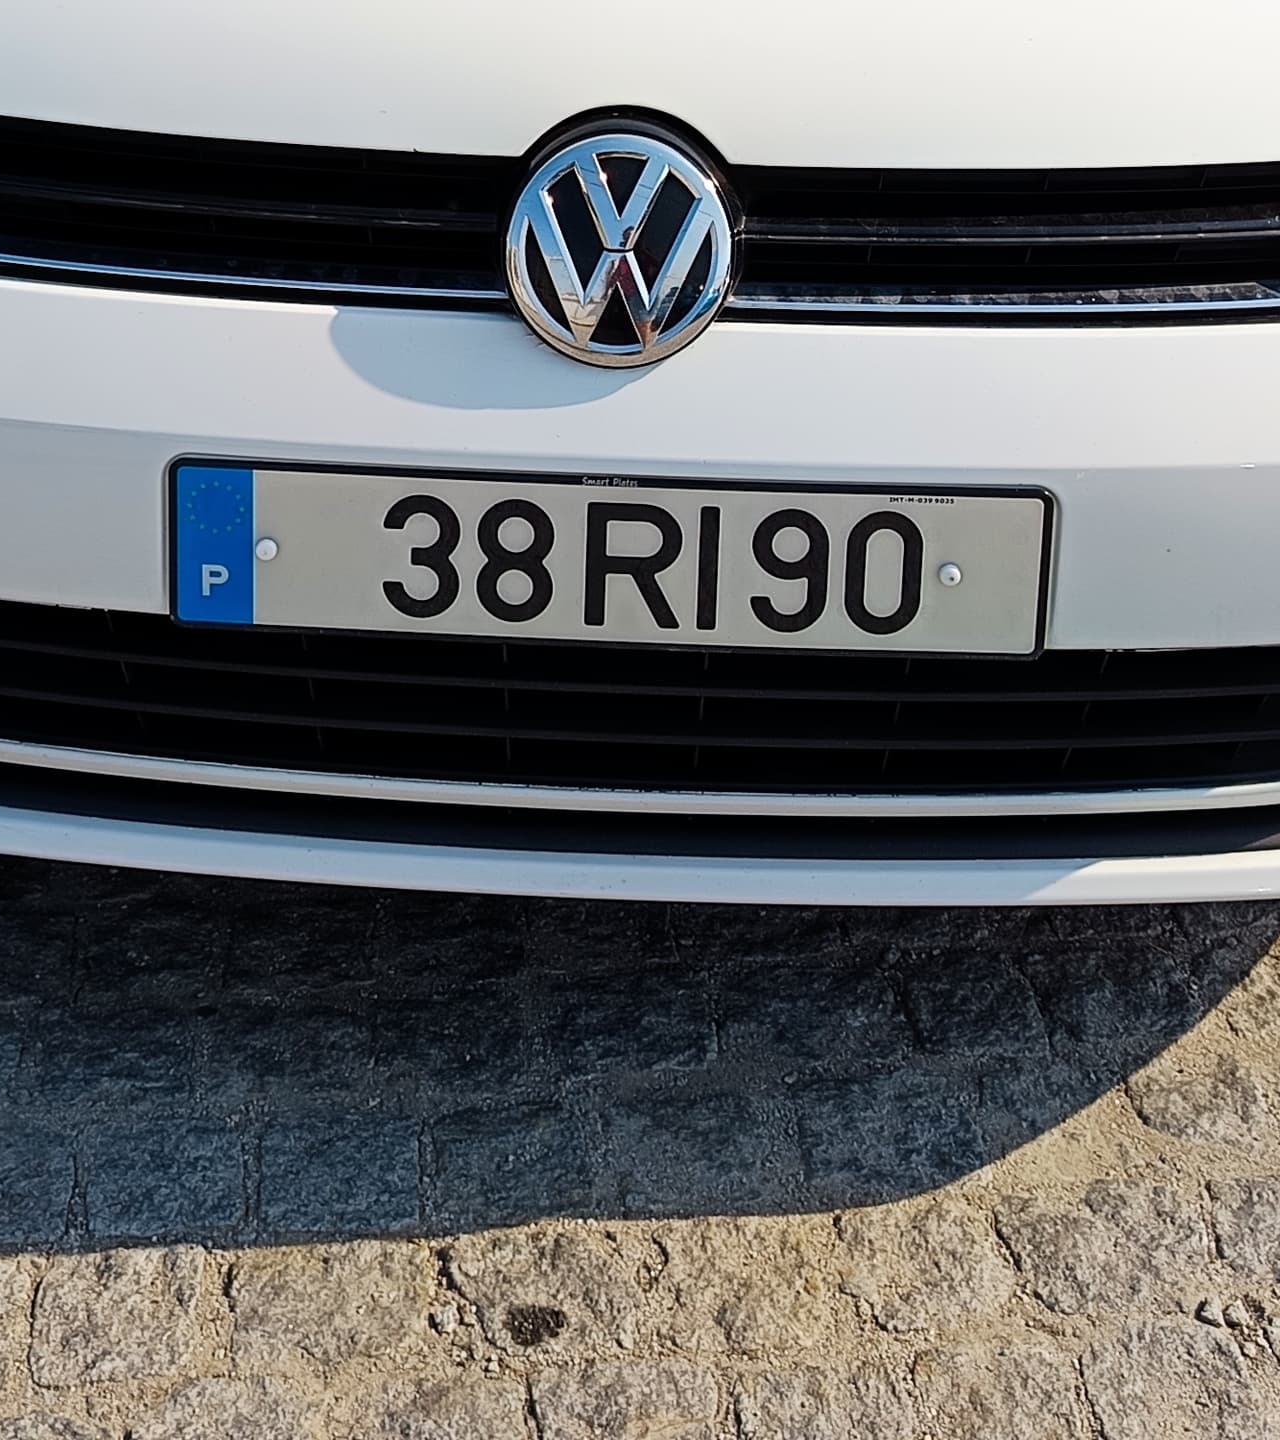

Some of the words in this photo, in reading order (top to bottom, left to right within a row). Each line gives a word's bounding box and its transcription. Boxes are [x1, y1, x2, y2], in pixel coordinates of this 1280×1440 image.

[582, 476, 609, 486] Smart
[613, 478, 638, 488] Plates
[201, 563, 230, 597] P
